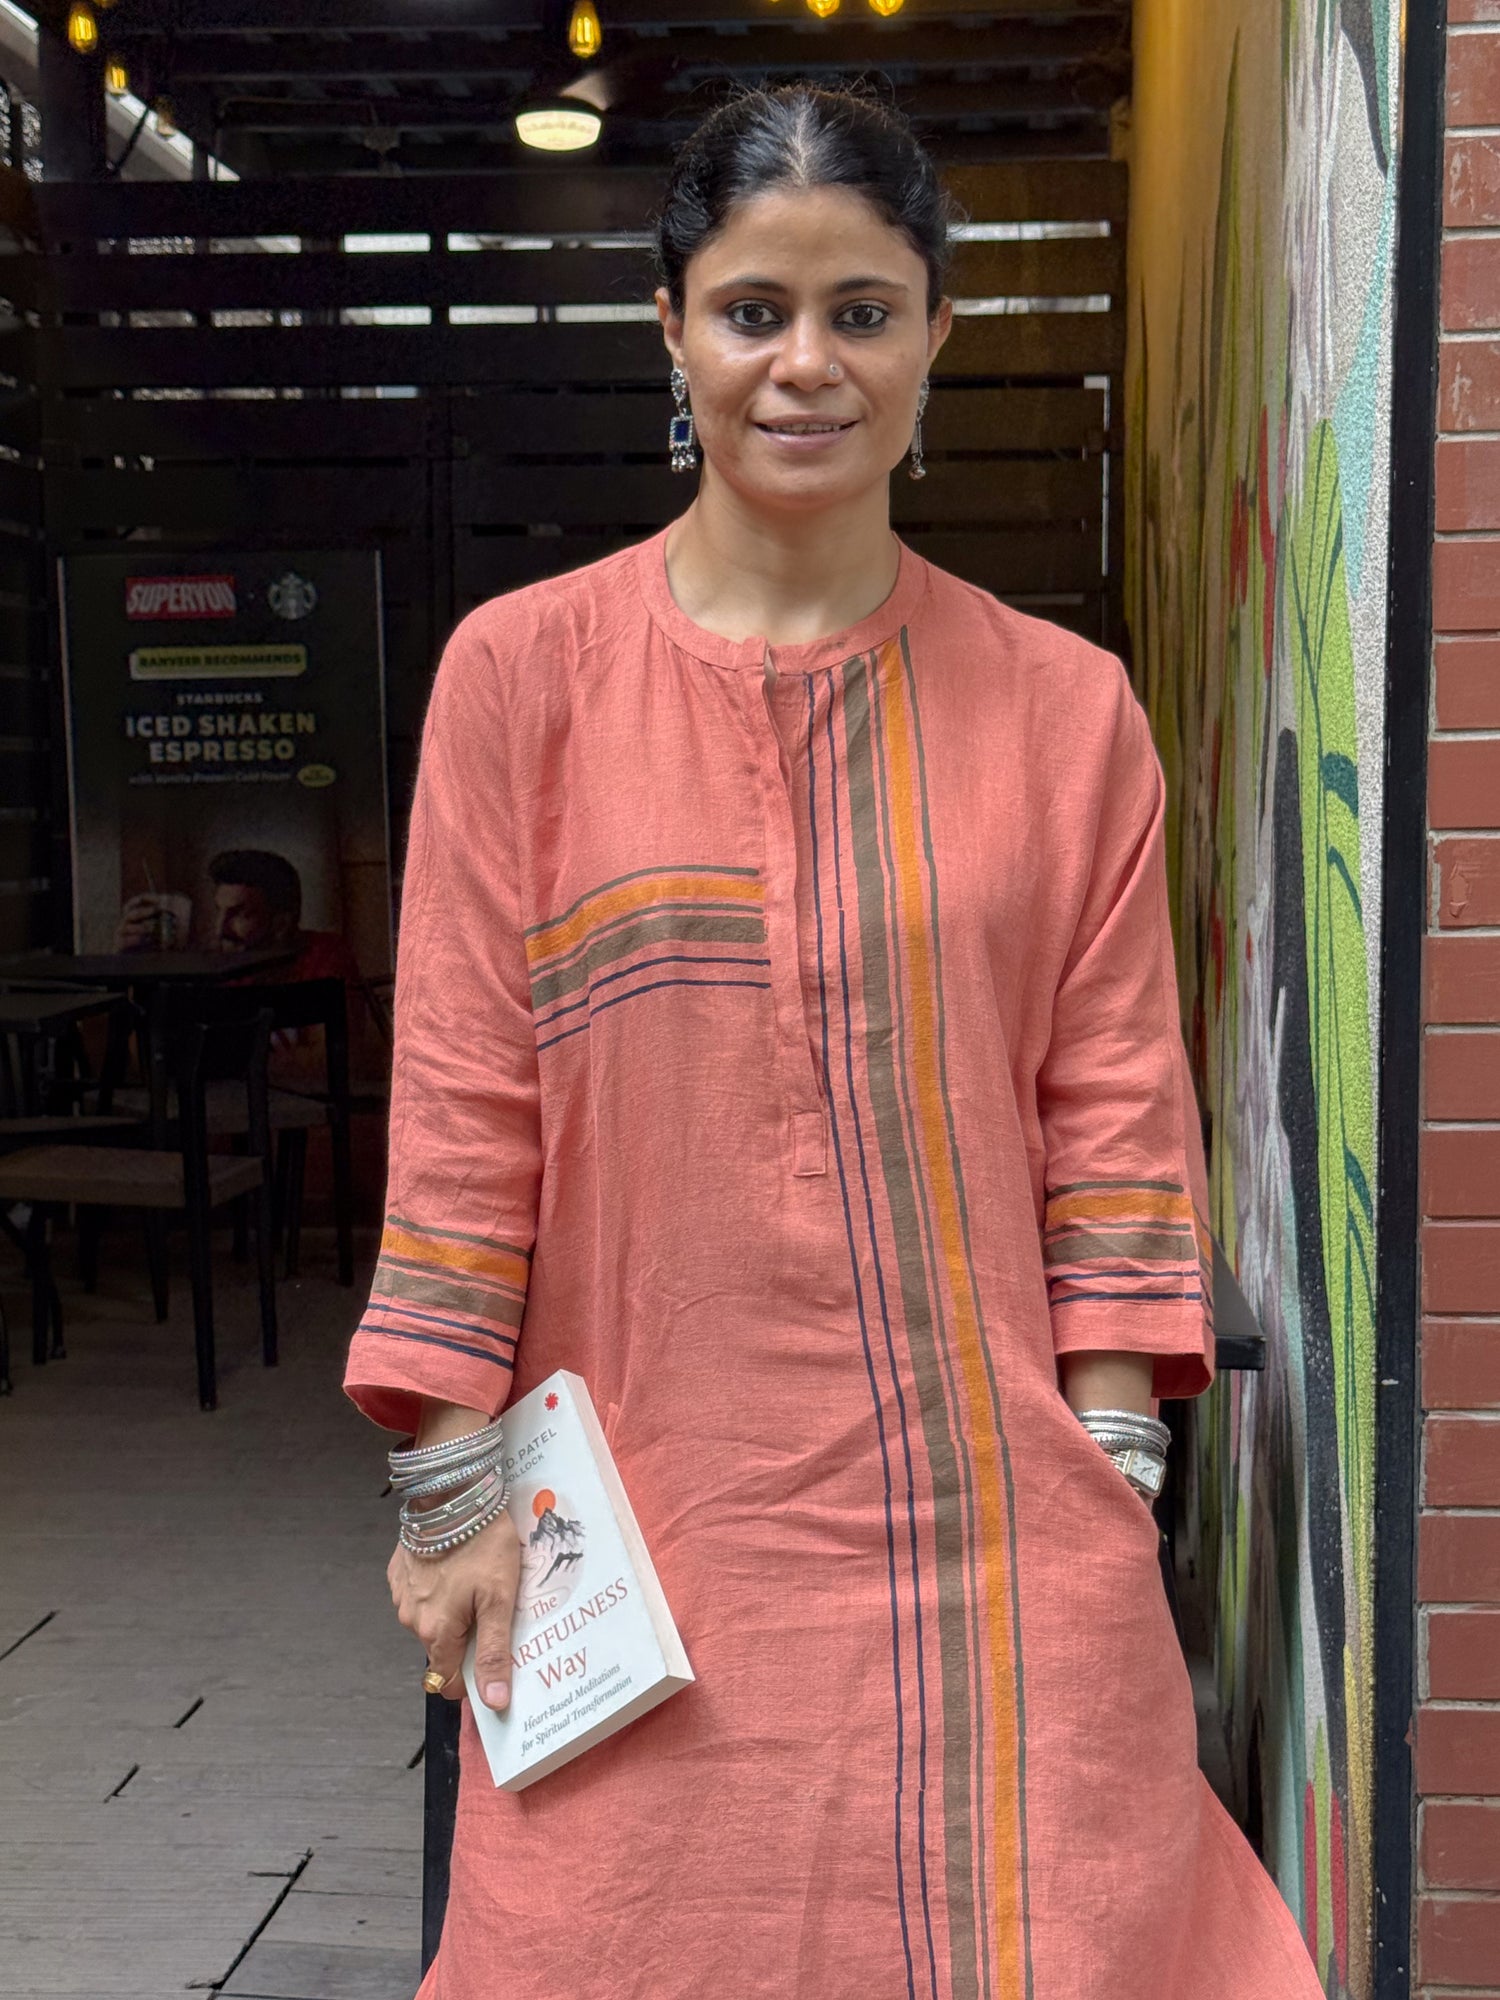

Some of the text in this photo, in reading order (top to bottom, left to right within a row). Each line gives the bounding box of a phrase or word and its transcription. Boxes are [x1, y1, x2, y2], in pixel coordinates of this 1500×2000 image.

[126, 582, 237, 614] SUPERYOU
[204, 653, 301, 666] RECOMMENDS
[176, 692, 264, 706] STARBUCKS
[125, 712, 317, 738] ICED SHAKEN
[148, 736, 297, 764] ESPRESSO
[518, 1428, 557, 1460] PATEL
[511, 1577, 628, 1670] ARTFULNESS
[530, 1596, 558, 1619] The
[536, 1646, 587, 1689] Way
[523, 1663, 621, 1732] Heart-Based Meditations
[521, 1675, 633, 1757] for Spiritual Transformation
